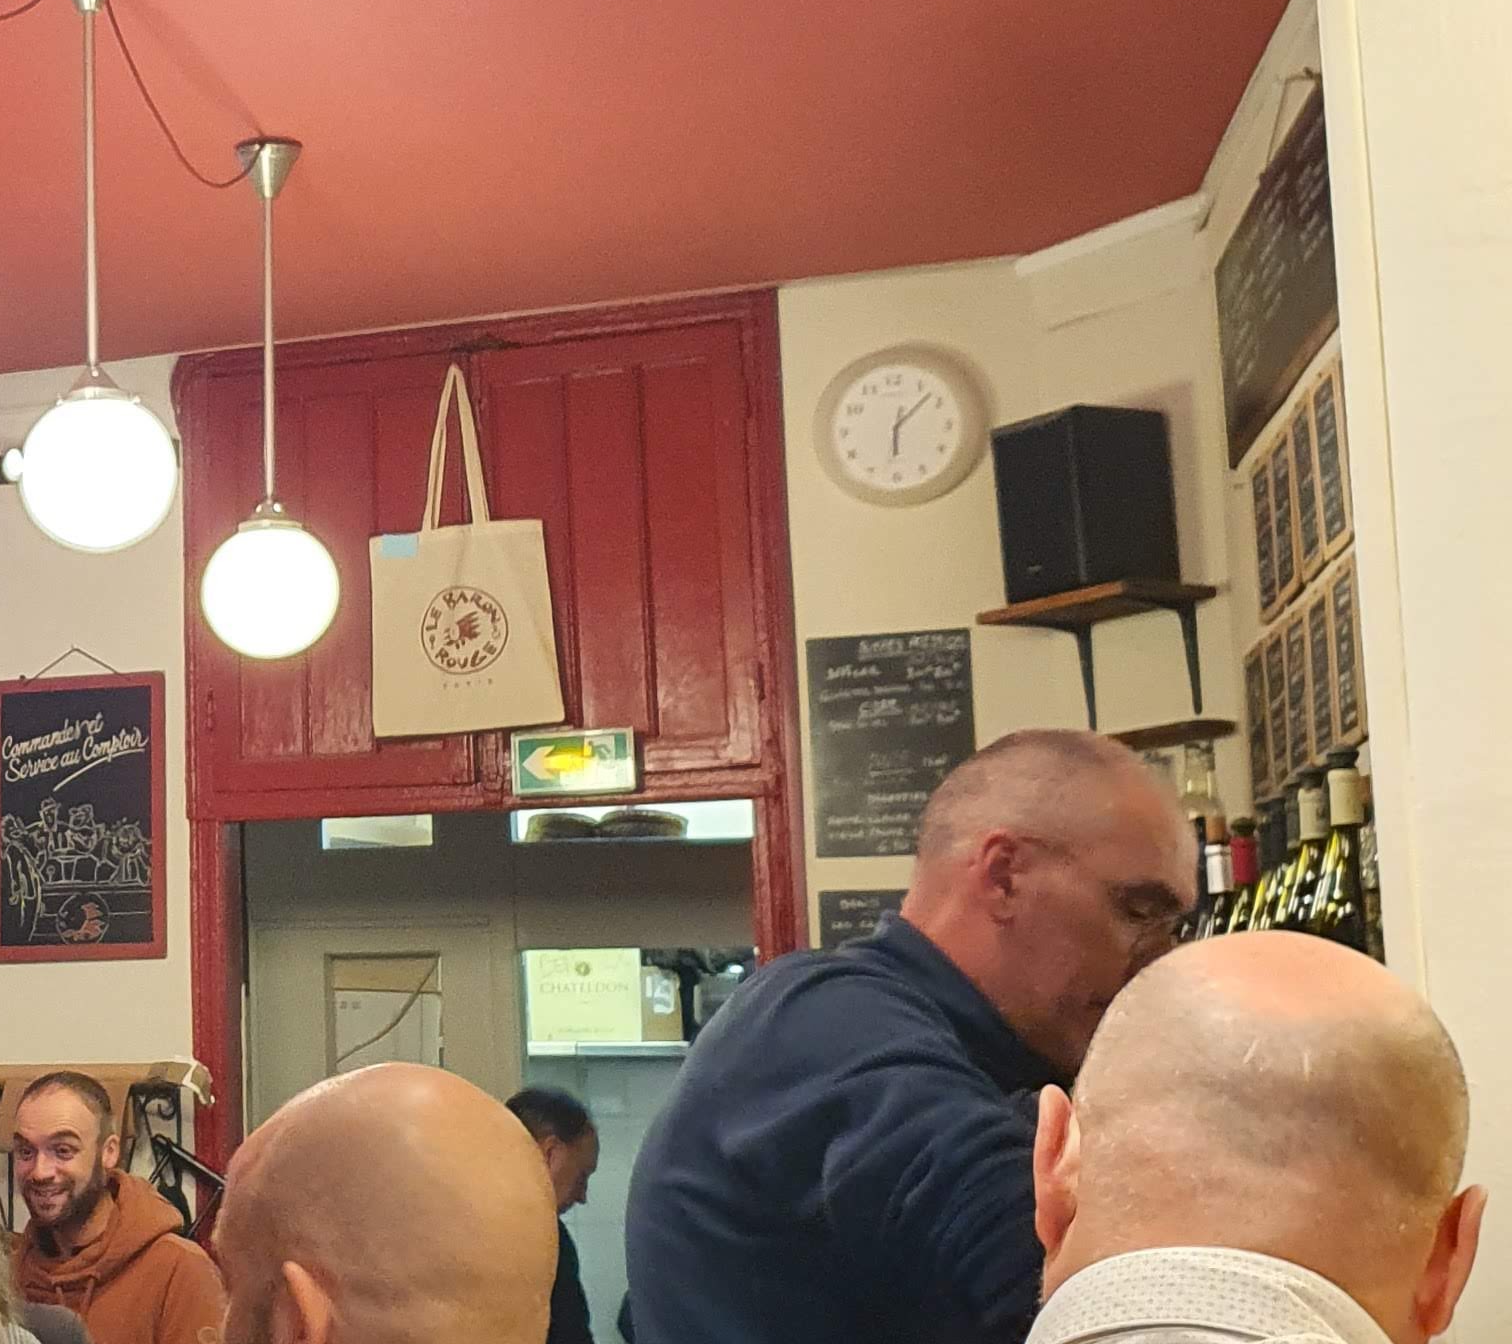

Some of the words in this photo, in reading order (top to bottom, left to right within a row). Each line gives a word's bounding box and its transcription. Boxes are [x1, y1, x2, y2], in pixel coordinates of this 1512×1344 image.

[425, 606, 443, 632] LE
[442, 590, 496, 624] BARON
[434, 640, 498, 670] ROUGE
[2, 718, 84, 760] Commandes
[88, 712, 104, 735] et
[5, 752, 59, 782] Service
[60, 748, 82, 767] au
[83, 726, 149, 762] Comptoir
[539, 981, 629, 994] CHATELDON
